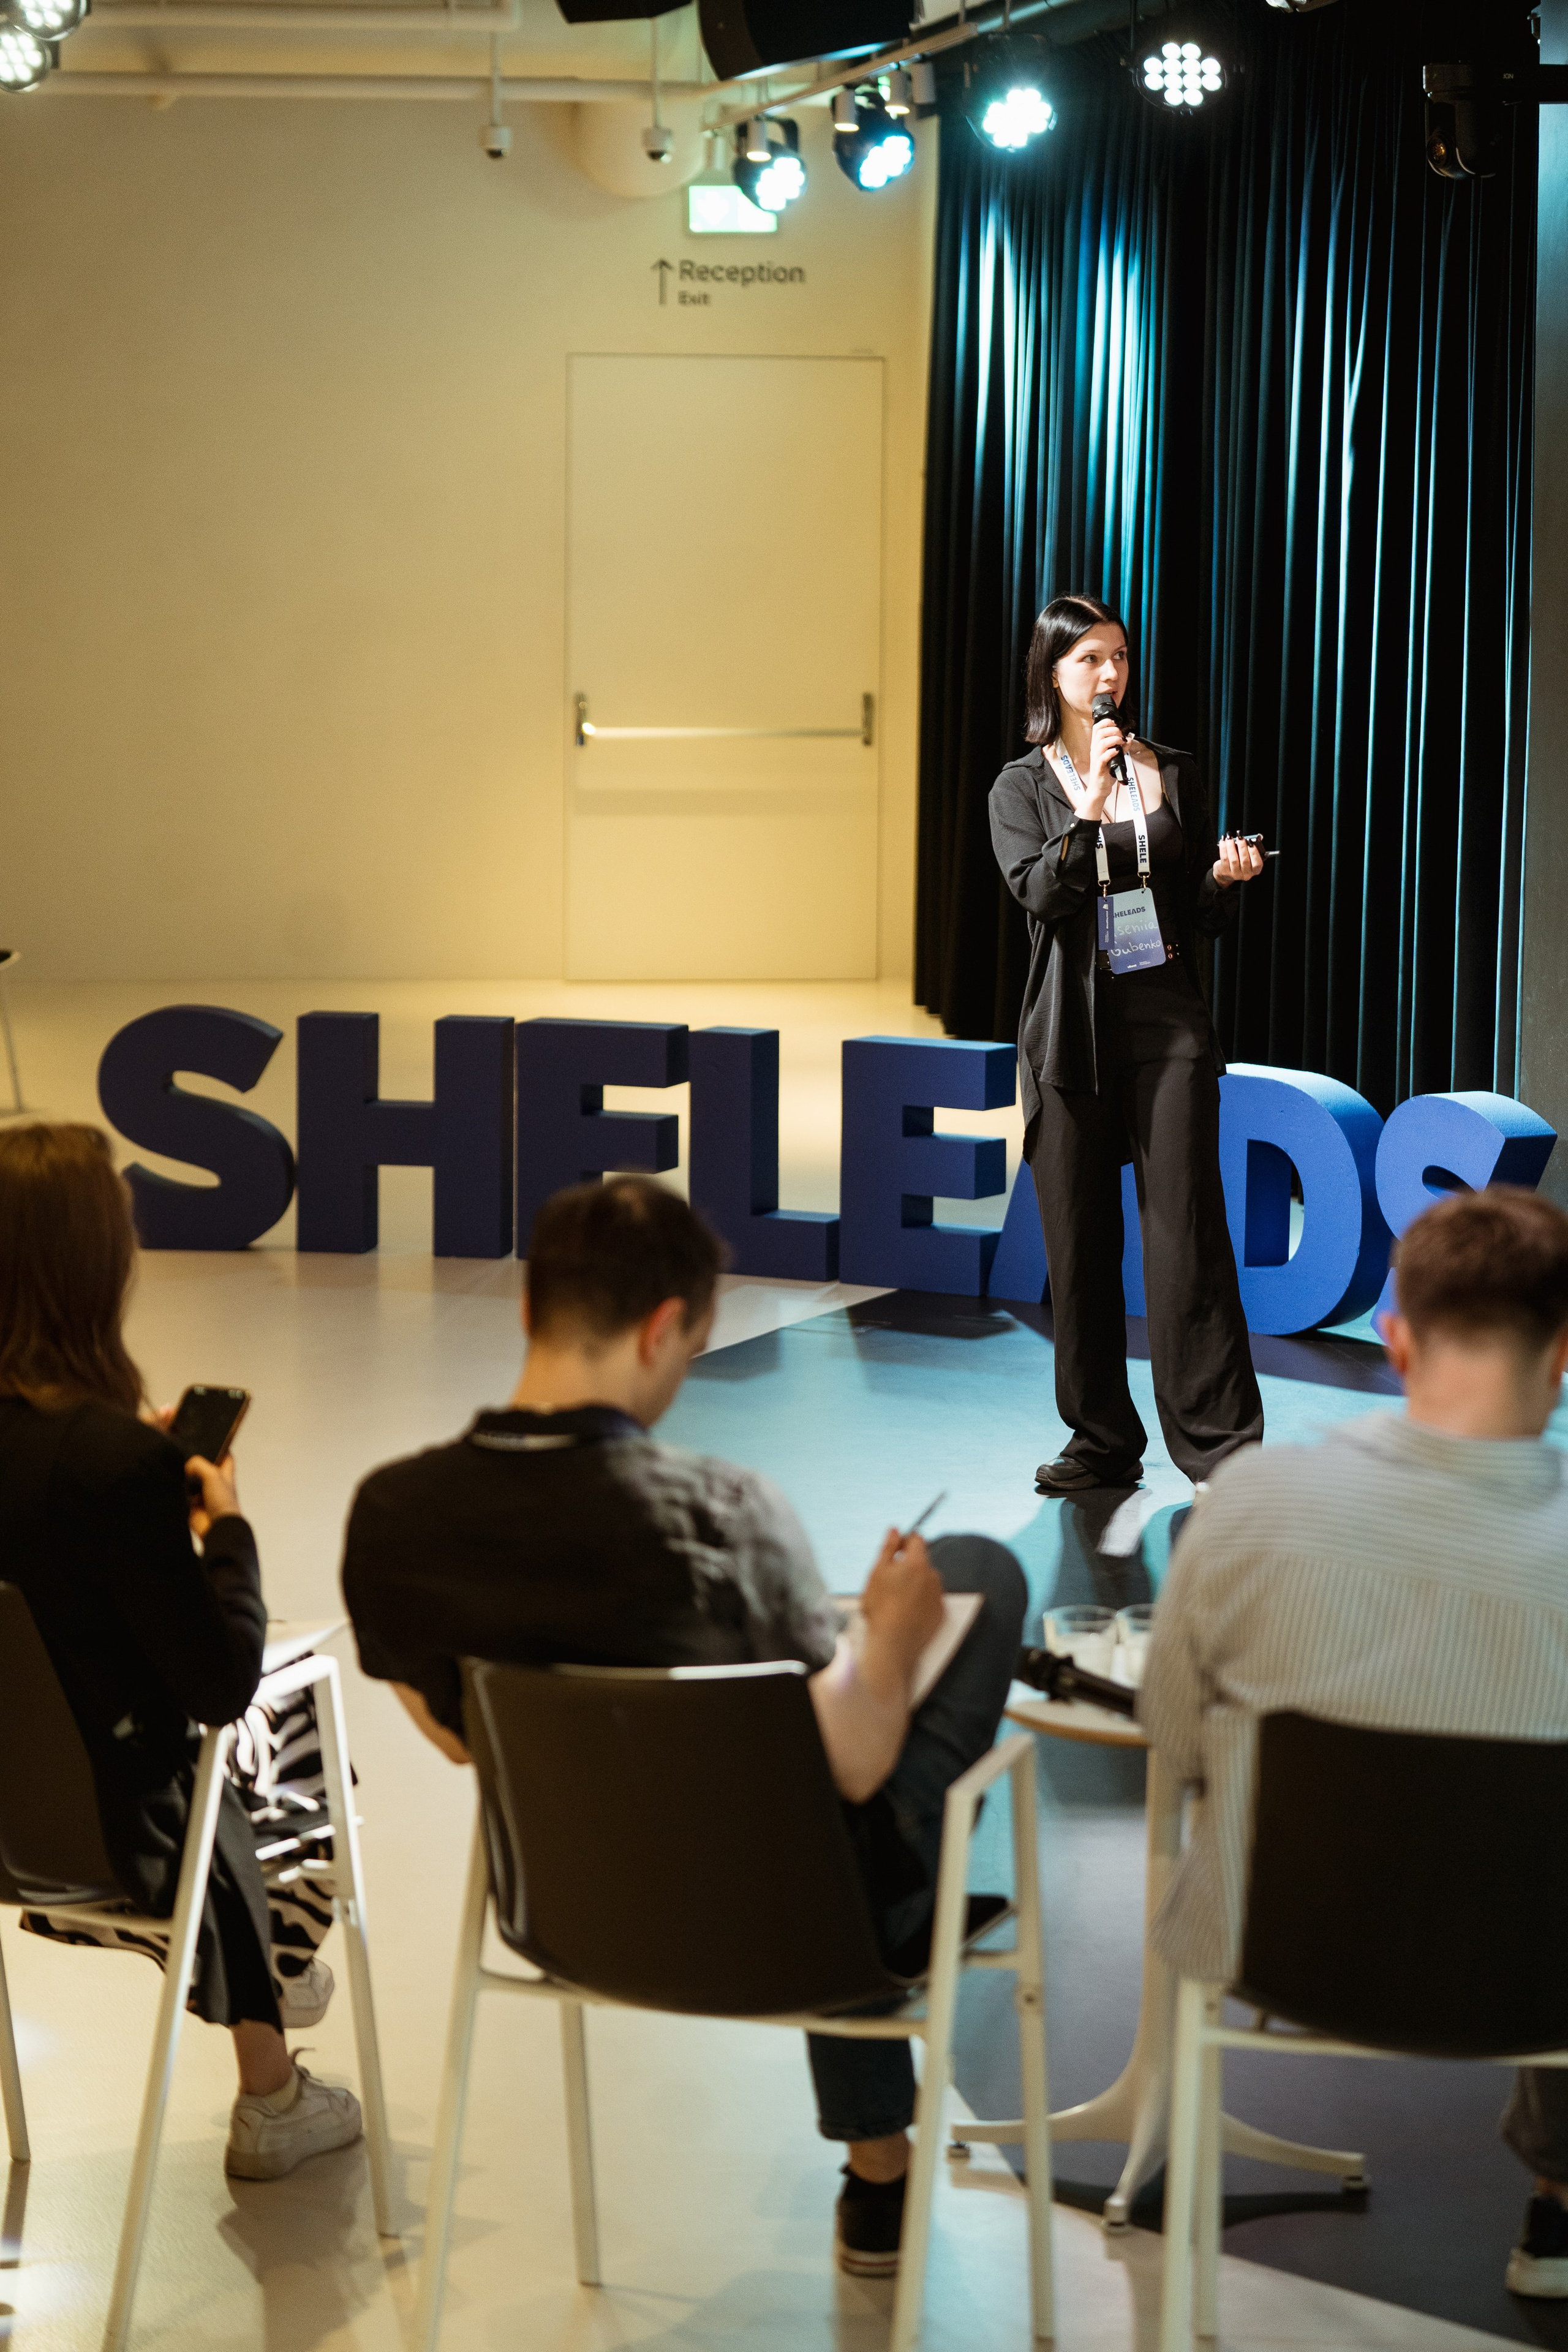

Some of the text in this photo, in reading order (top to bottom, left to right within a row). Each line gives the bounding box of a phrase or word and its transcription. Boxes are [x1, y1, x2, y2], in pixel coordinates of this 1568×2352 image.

[678, 259, 805, 287] Reception
[678, 290, 709, 306] Exit
[1114, 907, 1146, 918] HELEADS
[1114, 920, 1158, 937] seniia
[97, 1004, 1558, 1346] SHELEDS
